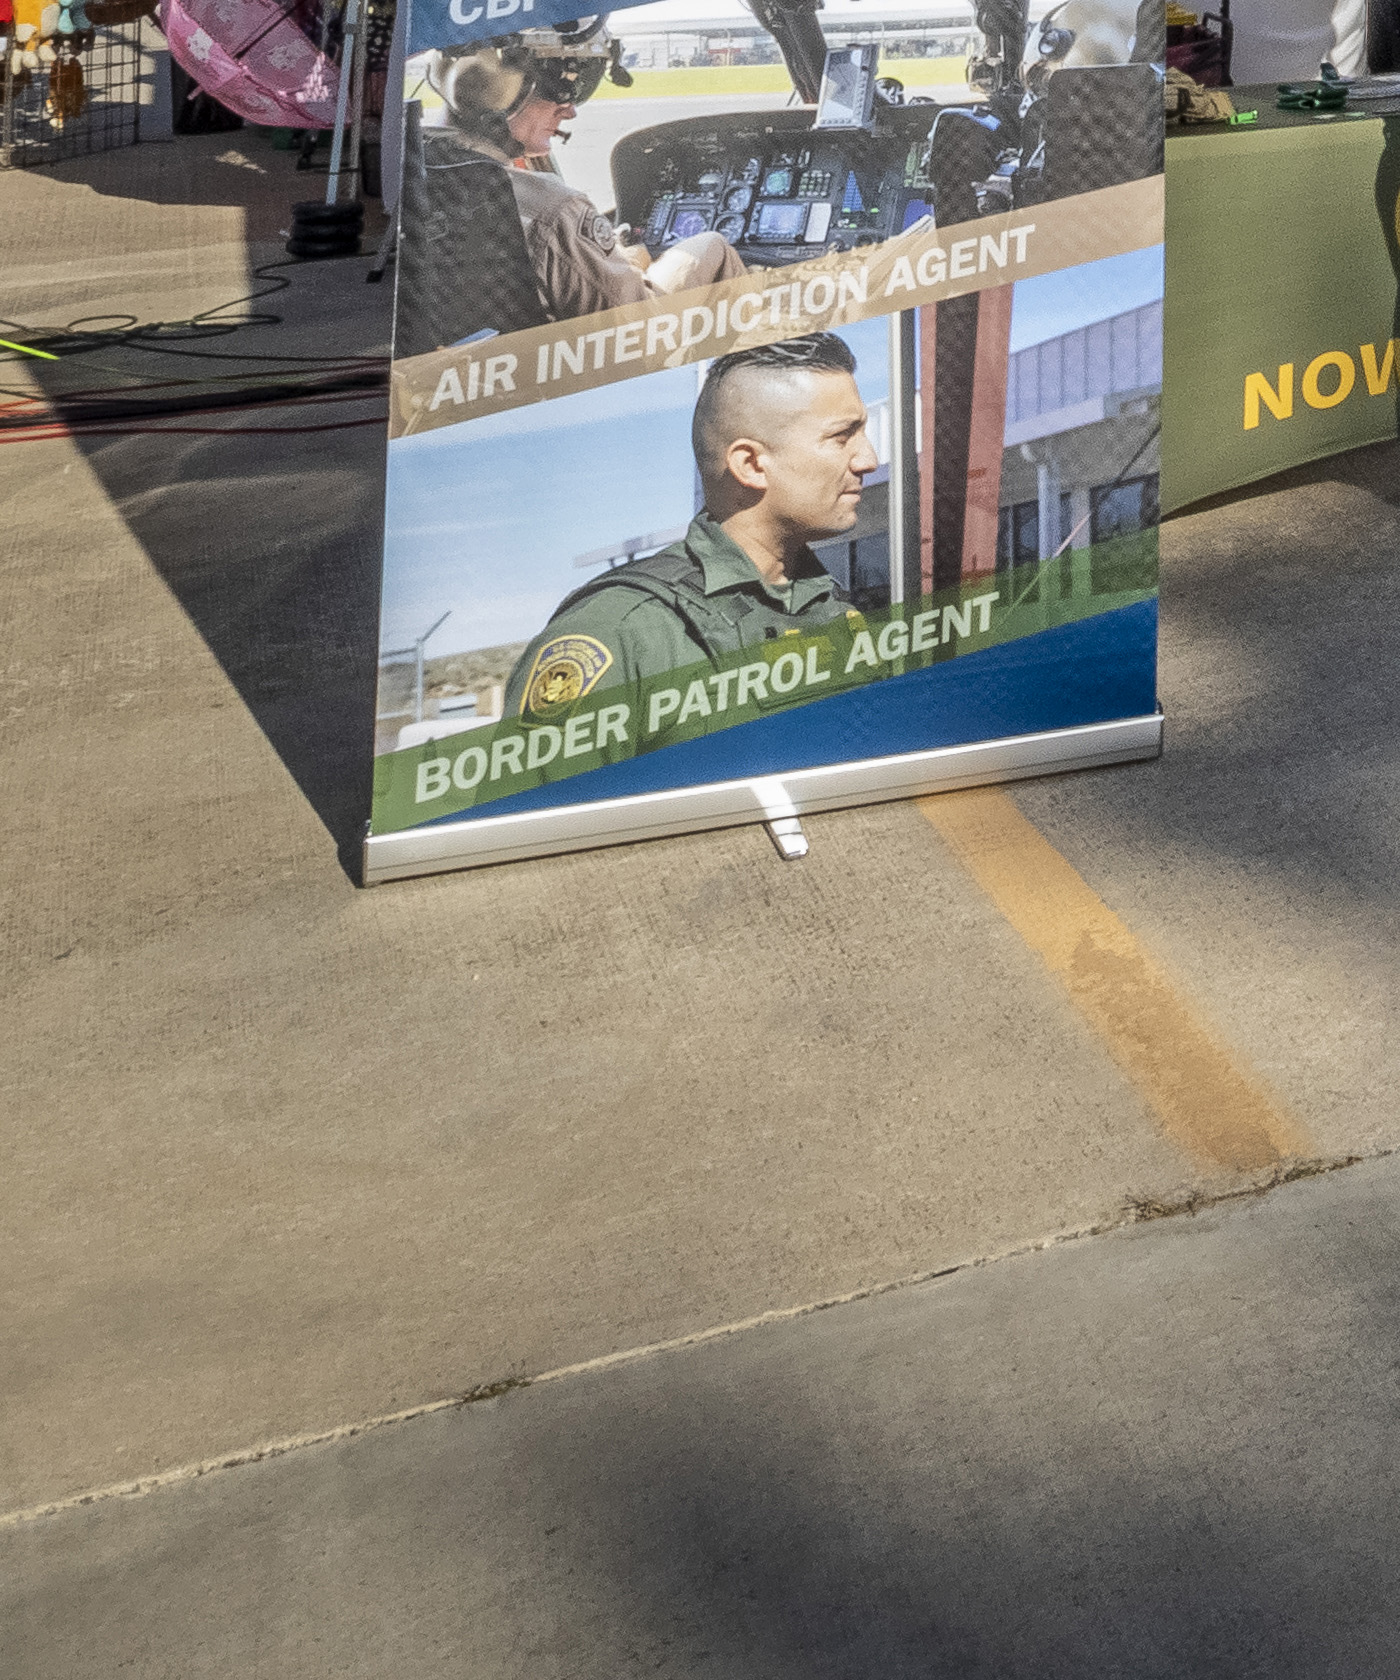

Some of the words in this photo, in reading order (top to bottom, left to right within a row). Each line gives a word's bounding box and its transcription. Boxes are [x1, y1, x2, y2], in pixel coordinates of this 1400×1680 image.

[430, 353, 518, 410] AIR
[537, 266, 869, 384] INTERDICTION
[886, 224, 1036, 296] AGENT
[415, 703, 628, 804] BORDER
[648, 652, 831, 733] PATROL
[845, 592, 1000, 674] AGENT
